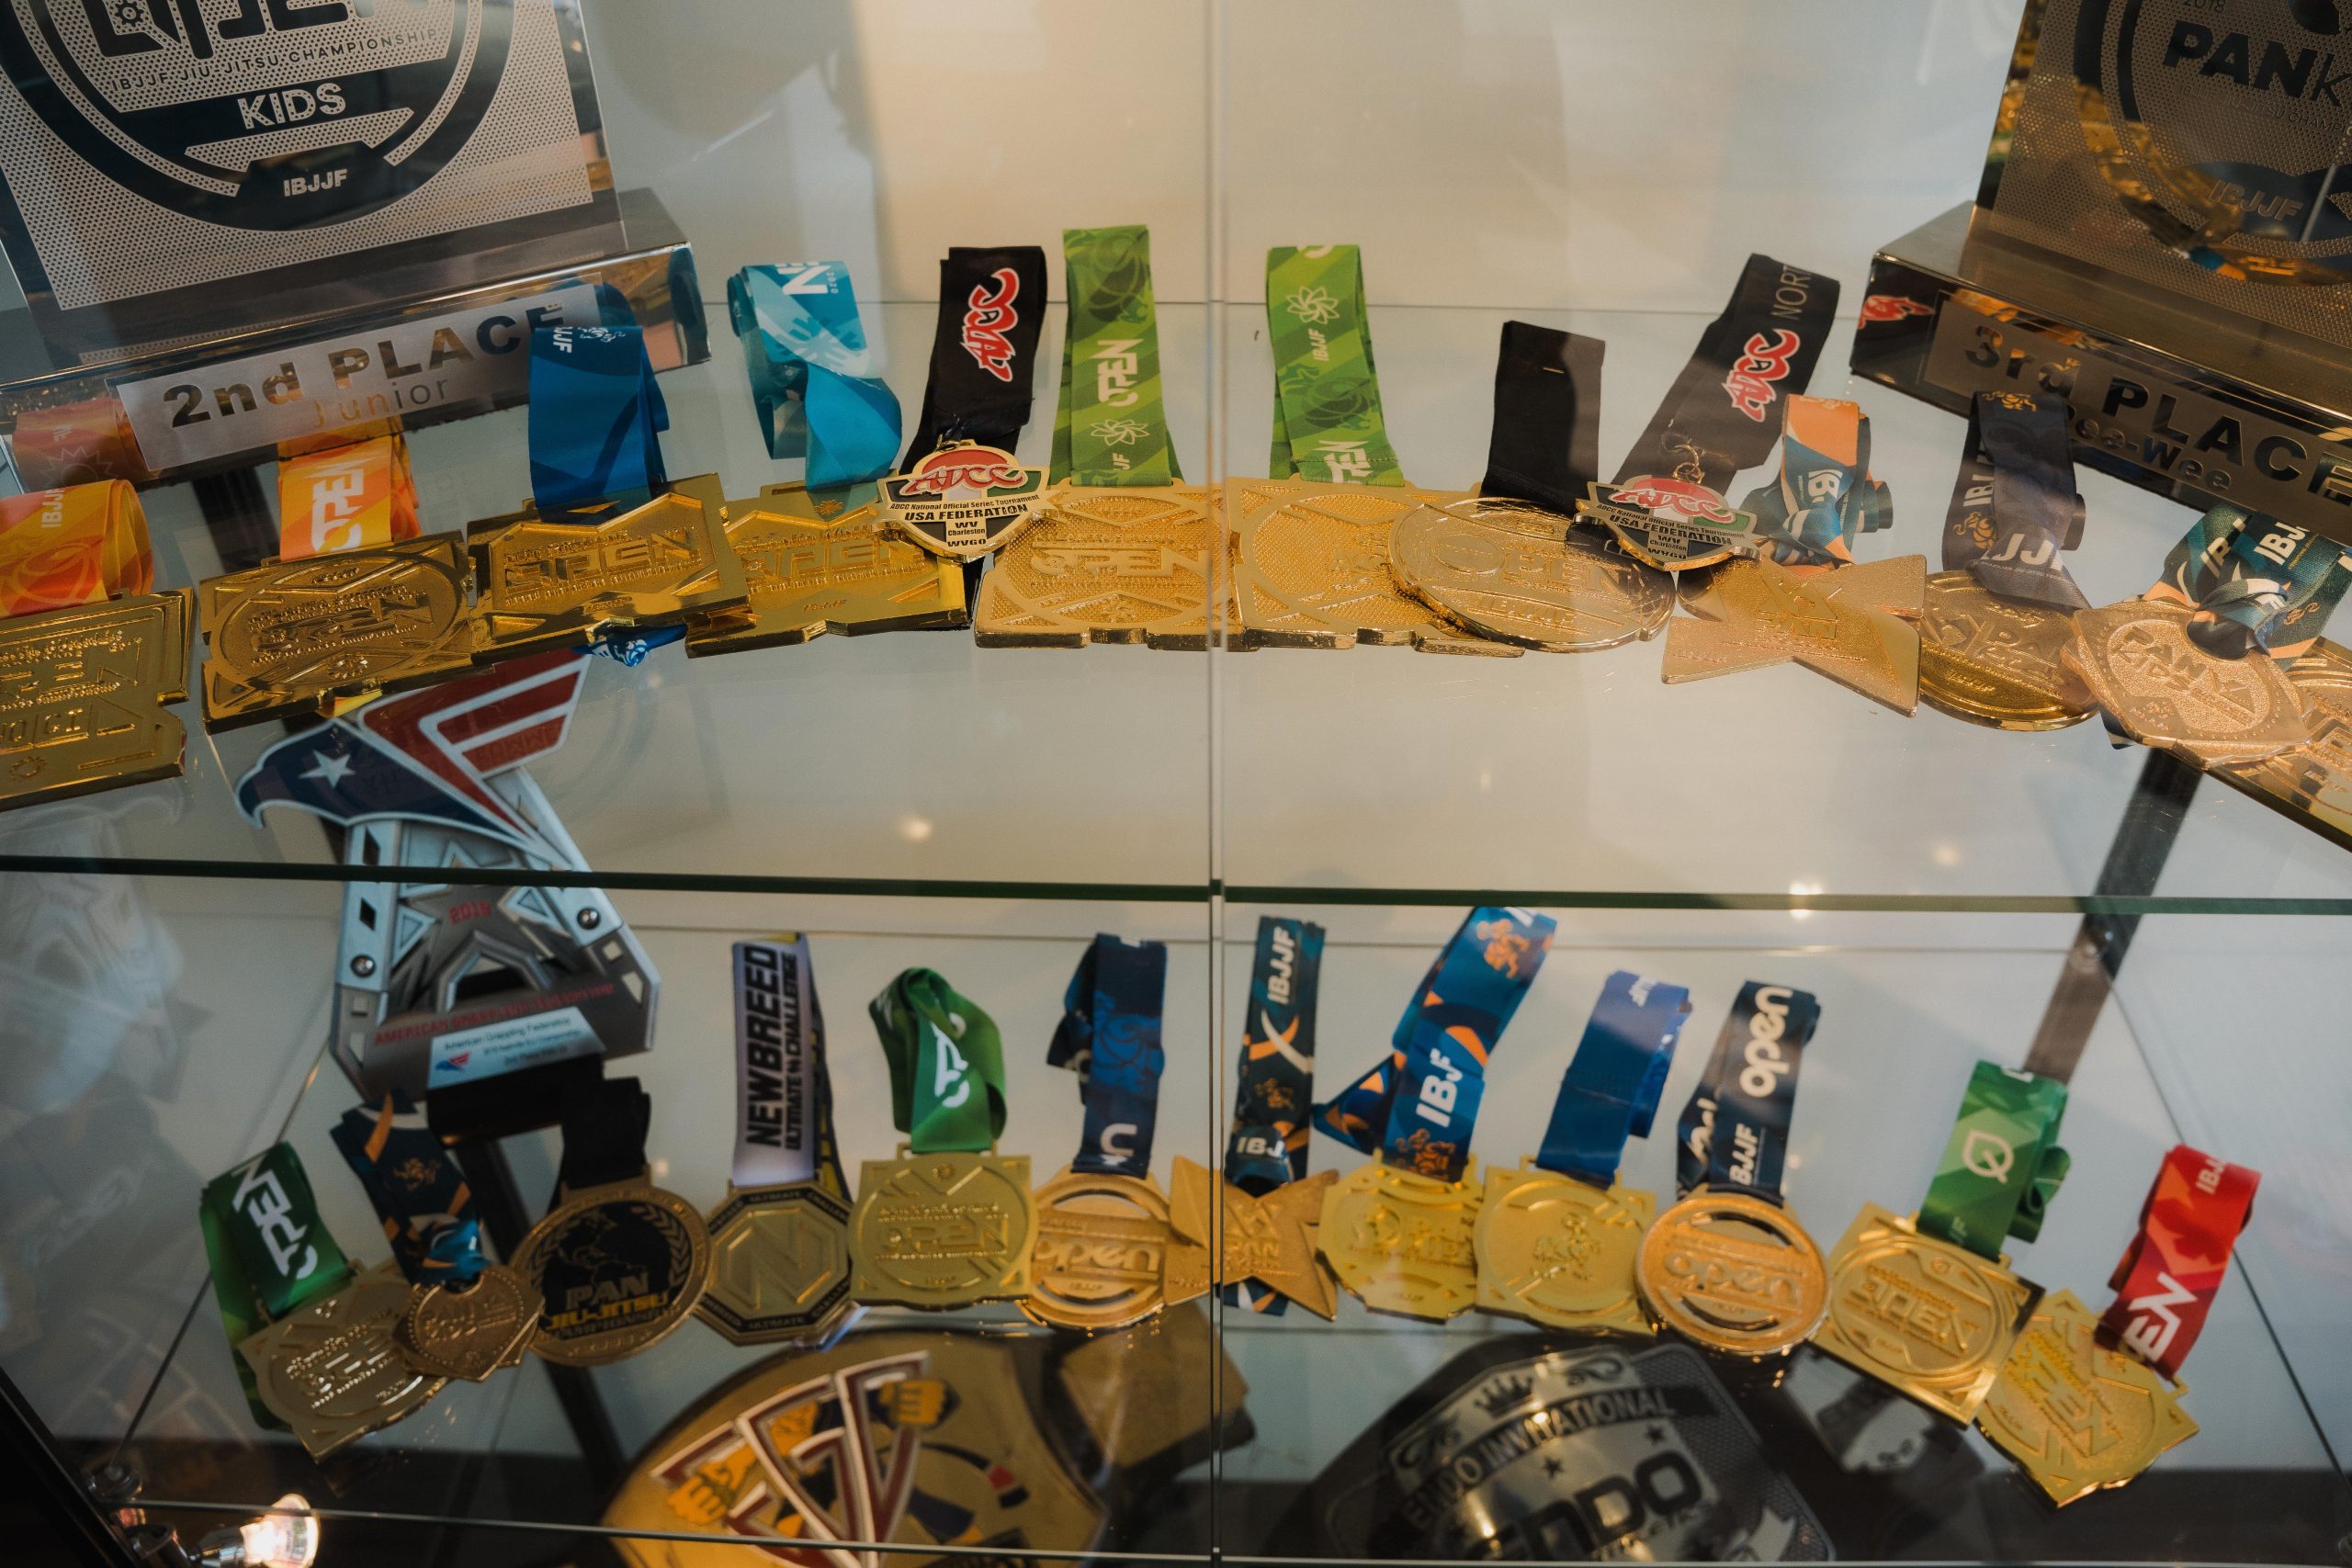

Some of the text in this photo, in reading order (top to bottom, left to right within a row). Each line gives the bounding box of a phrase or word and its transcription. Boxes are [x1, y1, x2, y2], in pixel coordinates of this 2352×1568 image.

[112, 71, 169, 91] IBJJF
[181, 53, 280, 82] JIU-JITSU
[288, 28, 438, 63] CHAMPIONSHIP
[237, 83, 346, 130] KIDS
[283, 169, 348, 197] IBJJF
[2203, 179, 2304, 224] IBJJF
[961, 268, 1020, 382] ADCC
[1308, 328, 1331, 363] IBJJF
[163, 362, 304, 428] 2nd
[1721, 329, 1801, 423] ADCC
[312, 376, 449, 430] Junior
[1964, 325, 2080, 400] 3rd
[2102, 377, 2352, 506] PLACE
[899, 464, 1028, 496] ADCC
[41, 489, 64, 529] IBJJ
[904, 504, 1029, 521] USA FEDERATION
[910, 502, 942, 511] National
[943, 502, 969, 510] Official
[970, 500, 994, 508] Series
[995, 494, 1040, 506] Tournament
[1609, 488, 1736, 524] ADCC
[1617, 509, 1647, 521] National
[1648, 517, 1675, 527] Official
[1676, 523, 1700, 532] Series
[1701, 527, 1746, 538] Tournament
[947, 527, 986, 536] Charleston
[1610, 514, 1733, 545] USA FEDERATION
[1649, 539, 1688, 551] Charleston
[1266, 926, 1295, 1005] IBJJF
[745, 943, 782, 1147] NEWBREED
[1739, 986, 1793, 1098] open
[1729, 1123, 1758, 1186] BJJF
[547, 1292, 670, 1331] JIU-JITSU
[566, 1271, 650, 1310] PAN
[1482, 1387, 1675, 1468] INVITATIONAL
